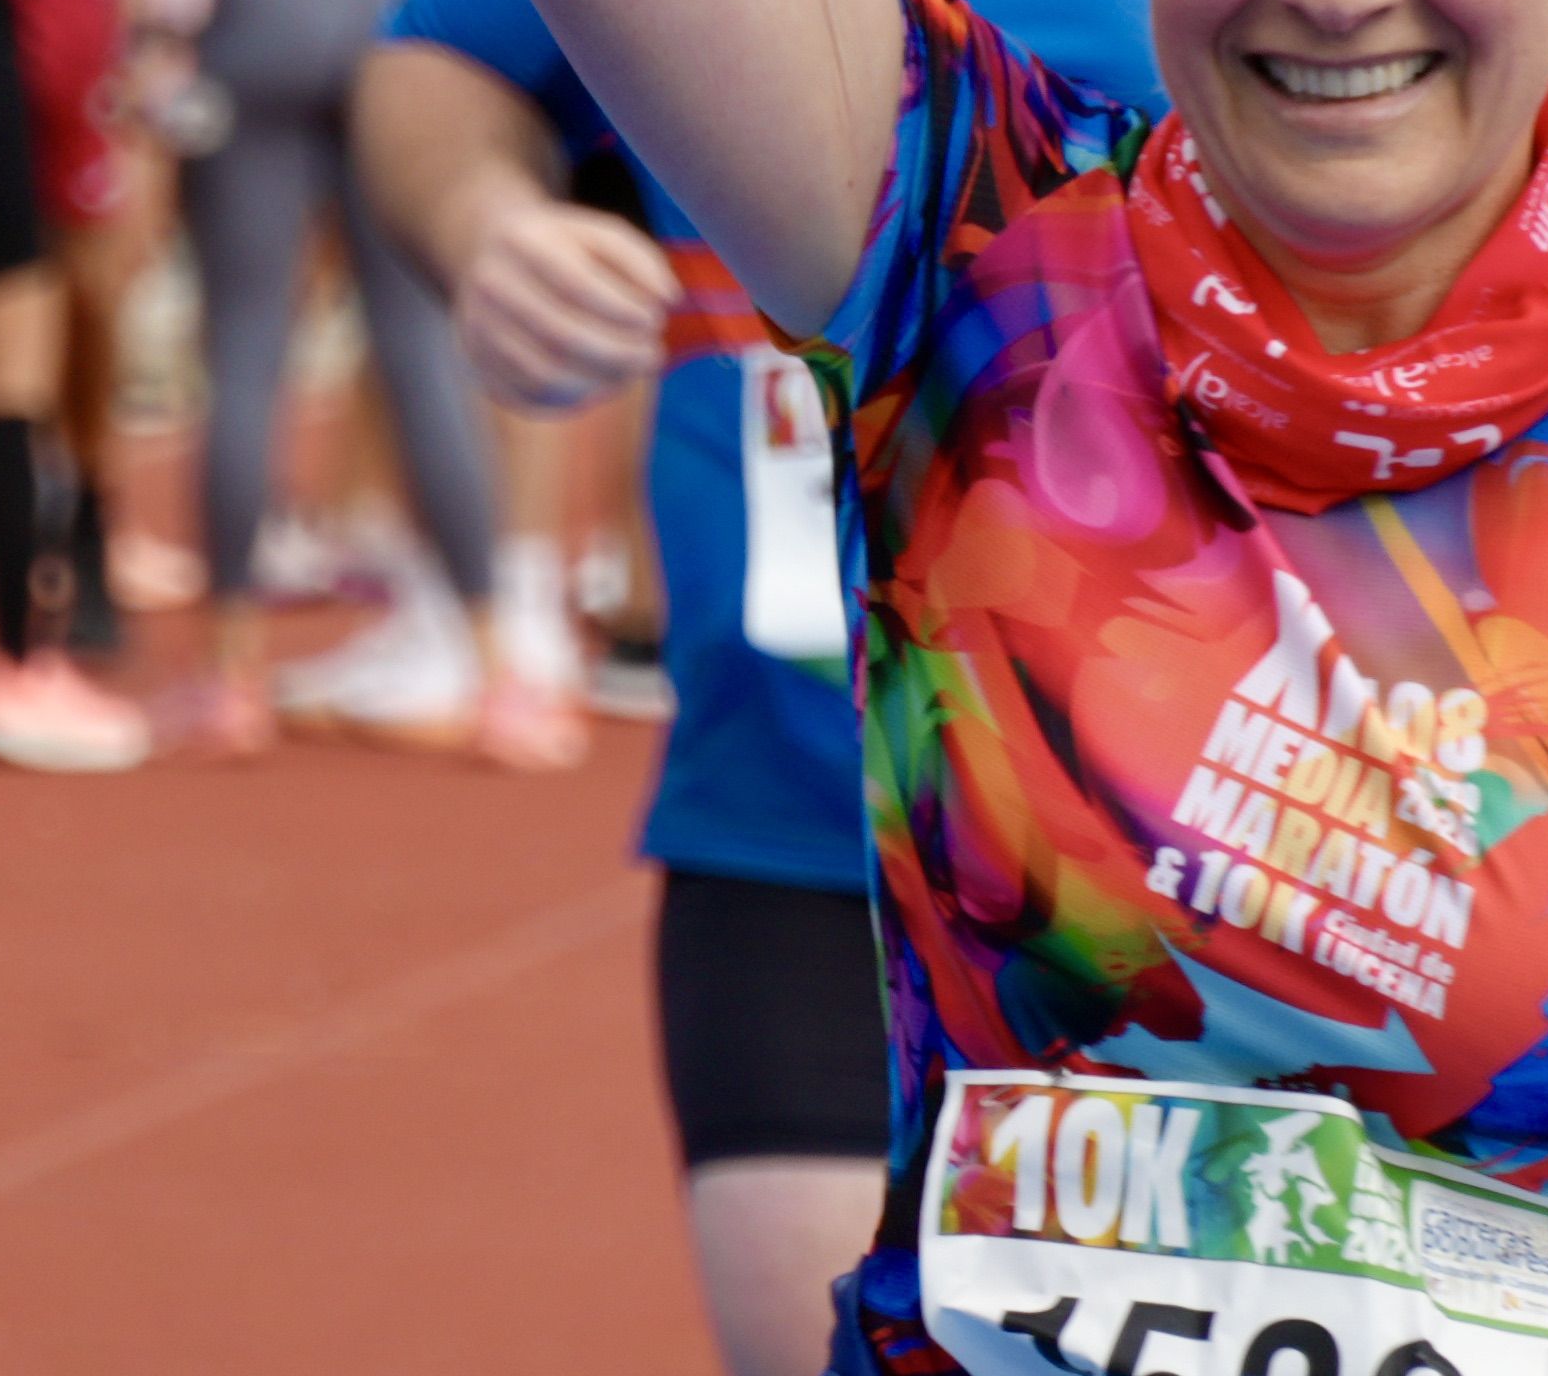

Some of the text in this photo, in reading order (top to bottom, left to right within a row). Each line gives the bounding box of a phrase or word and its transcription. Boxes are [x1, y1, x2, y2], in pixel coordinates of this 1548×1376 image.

[1201, 699, 1392, 840] MEDIA
[1388, 679, 1489, 774] 08
[1144, 846, 1323, 956] & 10K
[1170, 765, 1475, 951] MARATÓN
[1314, 932, 1447, 1021] LUCENA
[989, 1095, 1202, 1248] 10K
